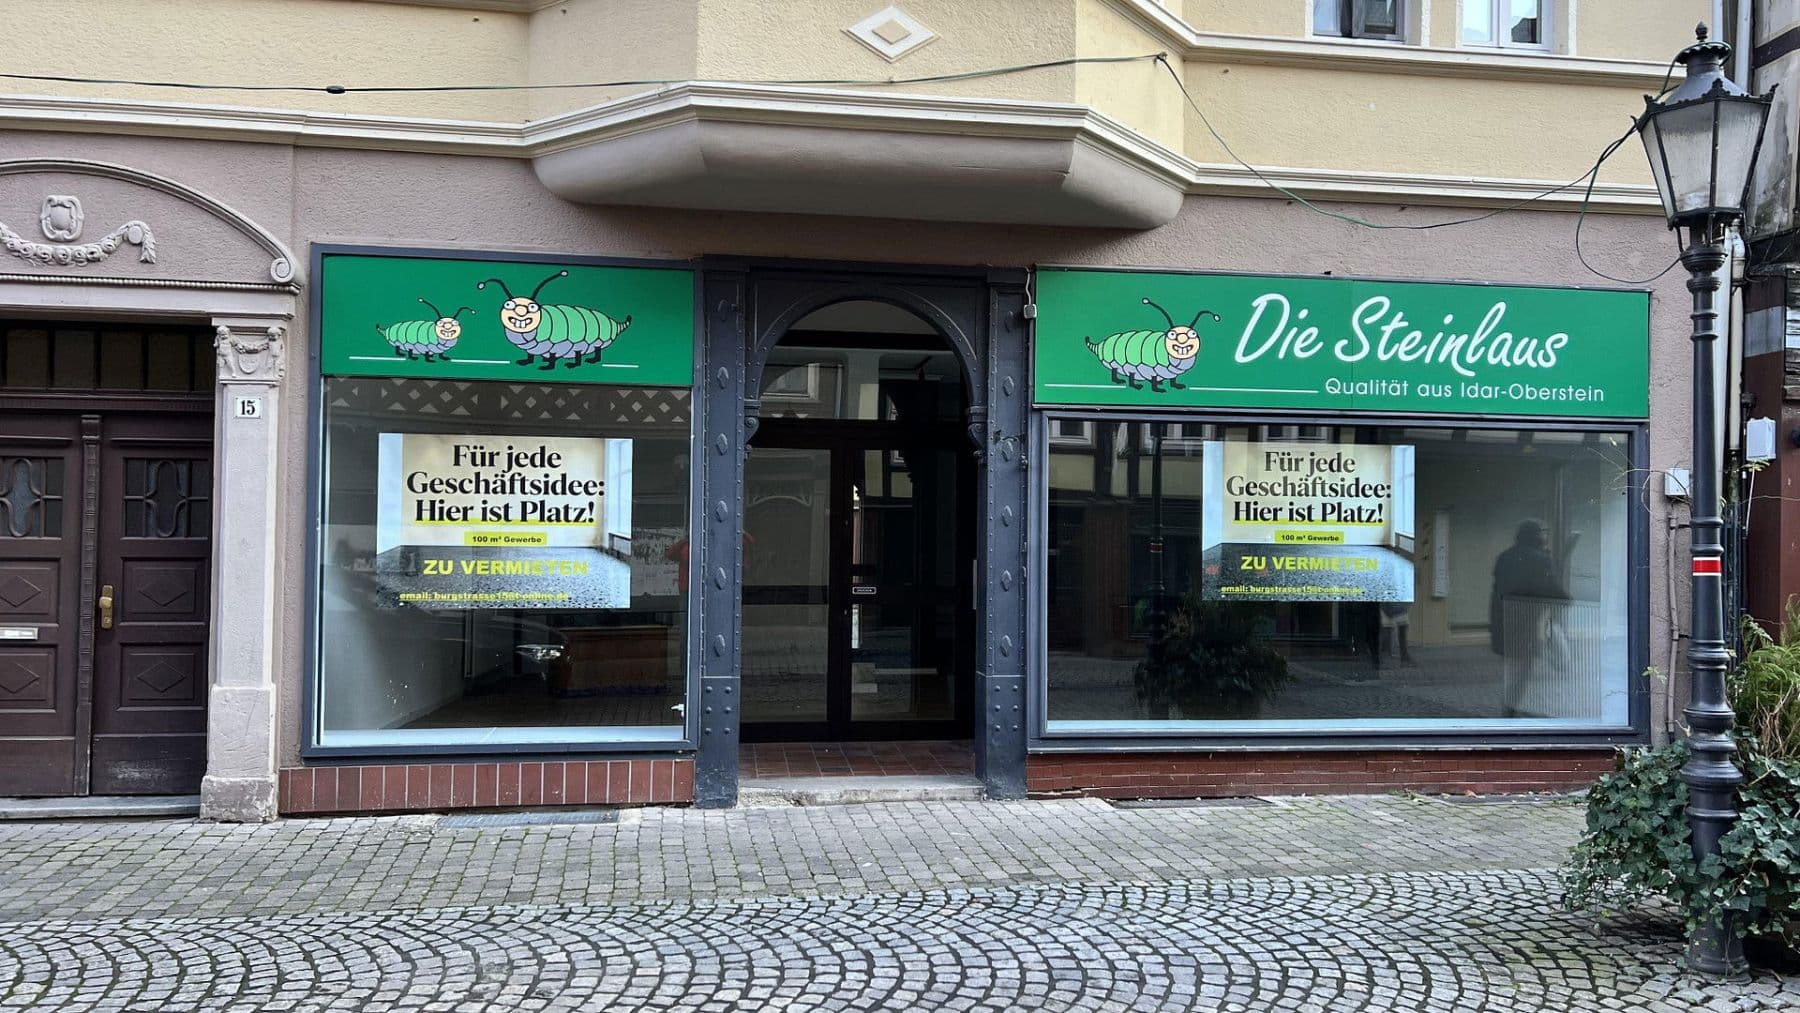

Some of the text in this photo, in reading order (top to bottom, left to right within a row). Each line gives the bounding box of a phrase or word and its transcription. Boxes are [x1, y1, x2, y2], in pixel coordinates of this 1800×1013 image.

[1234, 293, 1569, 376] Die Steinlaus
[1325, 376, 1604, 402] Qualität aus Idar-Oberstein
[241, 400, 256, 415] 15
[452, 444, 562, 473] Für jede
[1264, 451, 1355, 477] Für jede
[407, 471, 605, 497] Geschäftsidee:
[1226, 475, 1392, 499] Geschäftsidee:
[415, 499, 595, 523] Hier ist Platz!
[1233, 500, 1384, 523] Hier ist Platz!
[1307, 534, 1340, 542] Gewerbe
[423, 560, 589, 576] ZU VERMIETEN
[1241, 556, 1378, 571] ZU VERMIETEN
[399, 591, 431, 601] email:
[1220, 586, 1248, 595] email:
